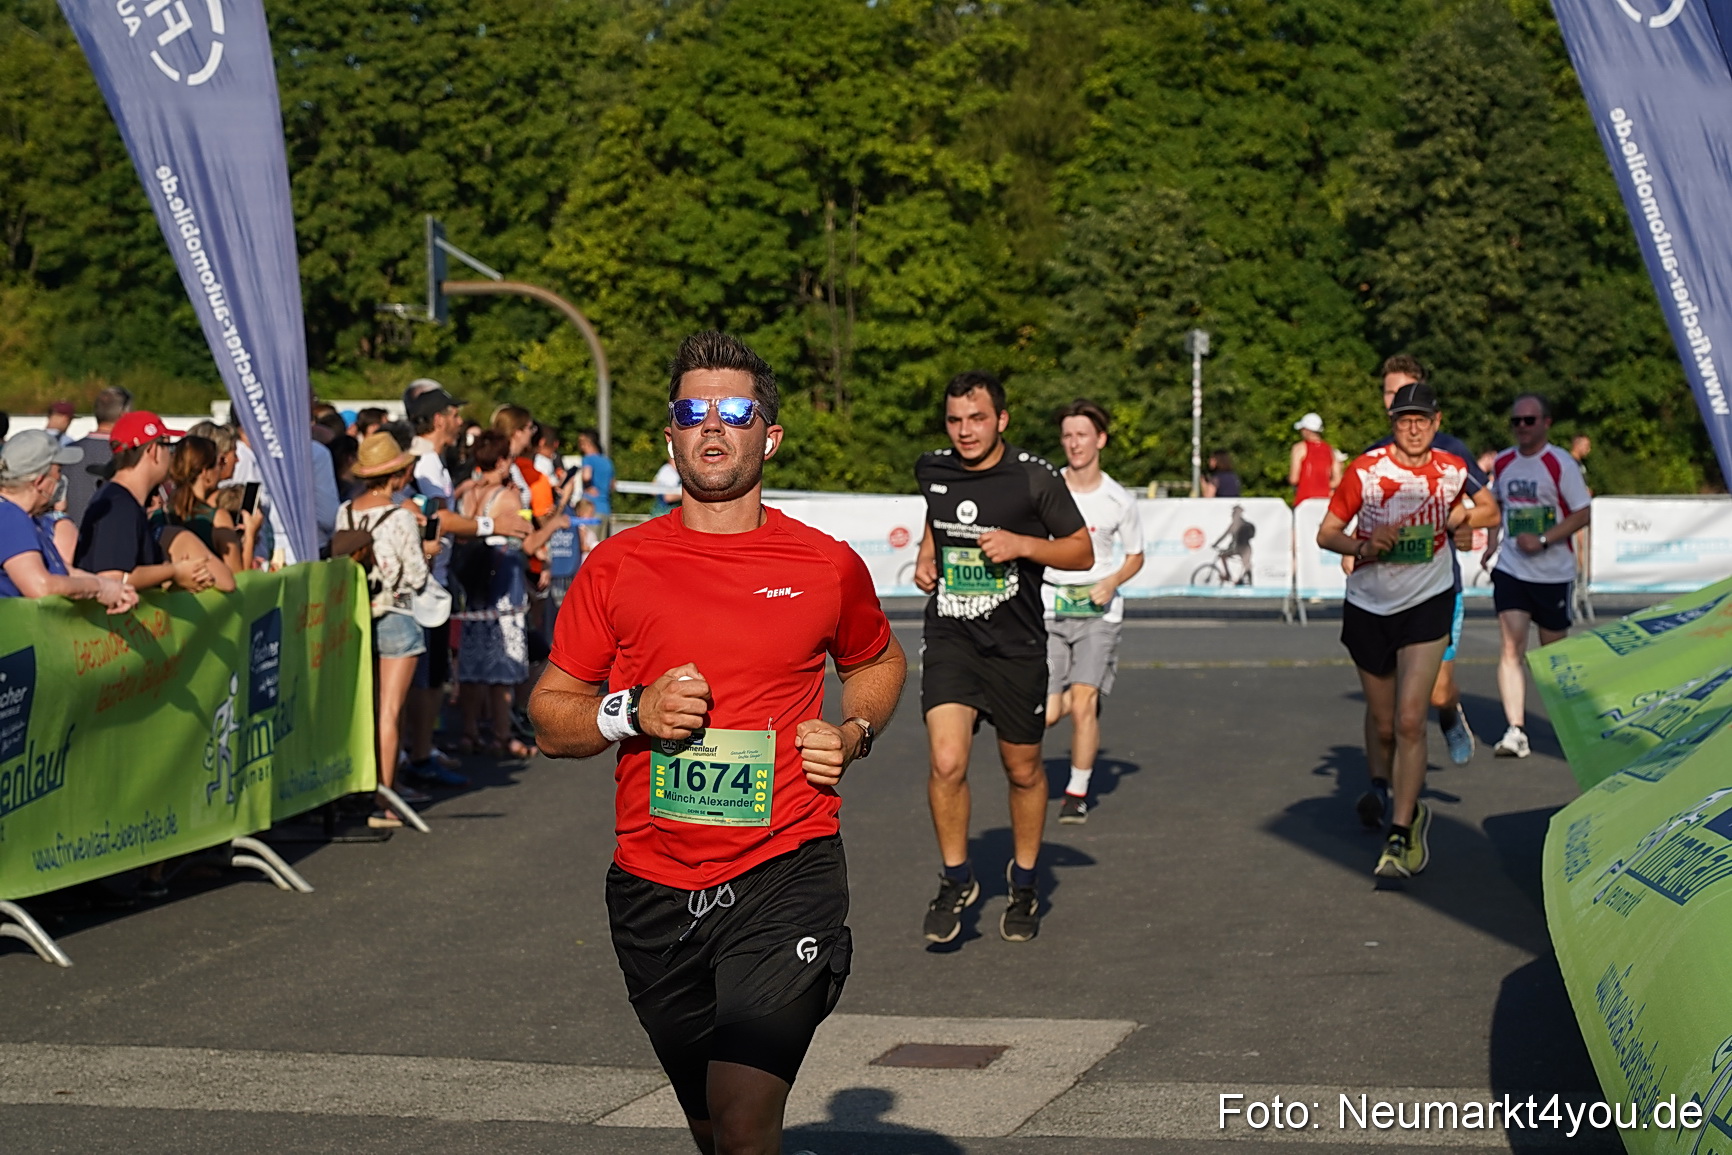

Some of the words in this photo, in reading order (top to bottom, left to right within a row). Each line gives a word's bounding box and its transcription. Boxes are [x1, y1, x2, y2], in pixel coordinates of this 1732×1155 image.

[766, 586, 792, 598] DEHN
[655, 764, 666, 798] RUN
[668, 758, 753, 795] 1674
[754, 769, 768, 813] 2022
[664, 789, 696, 805] Münch
[698, 795, 755, 808] Alexander
